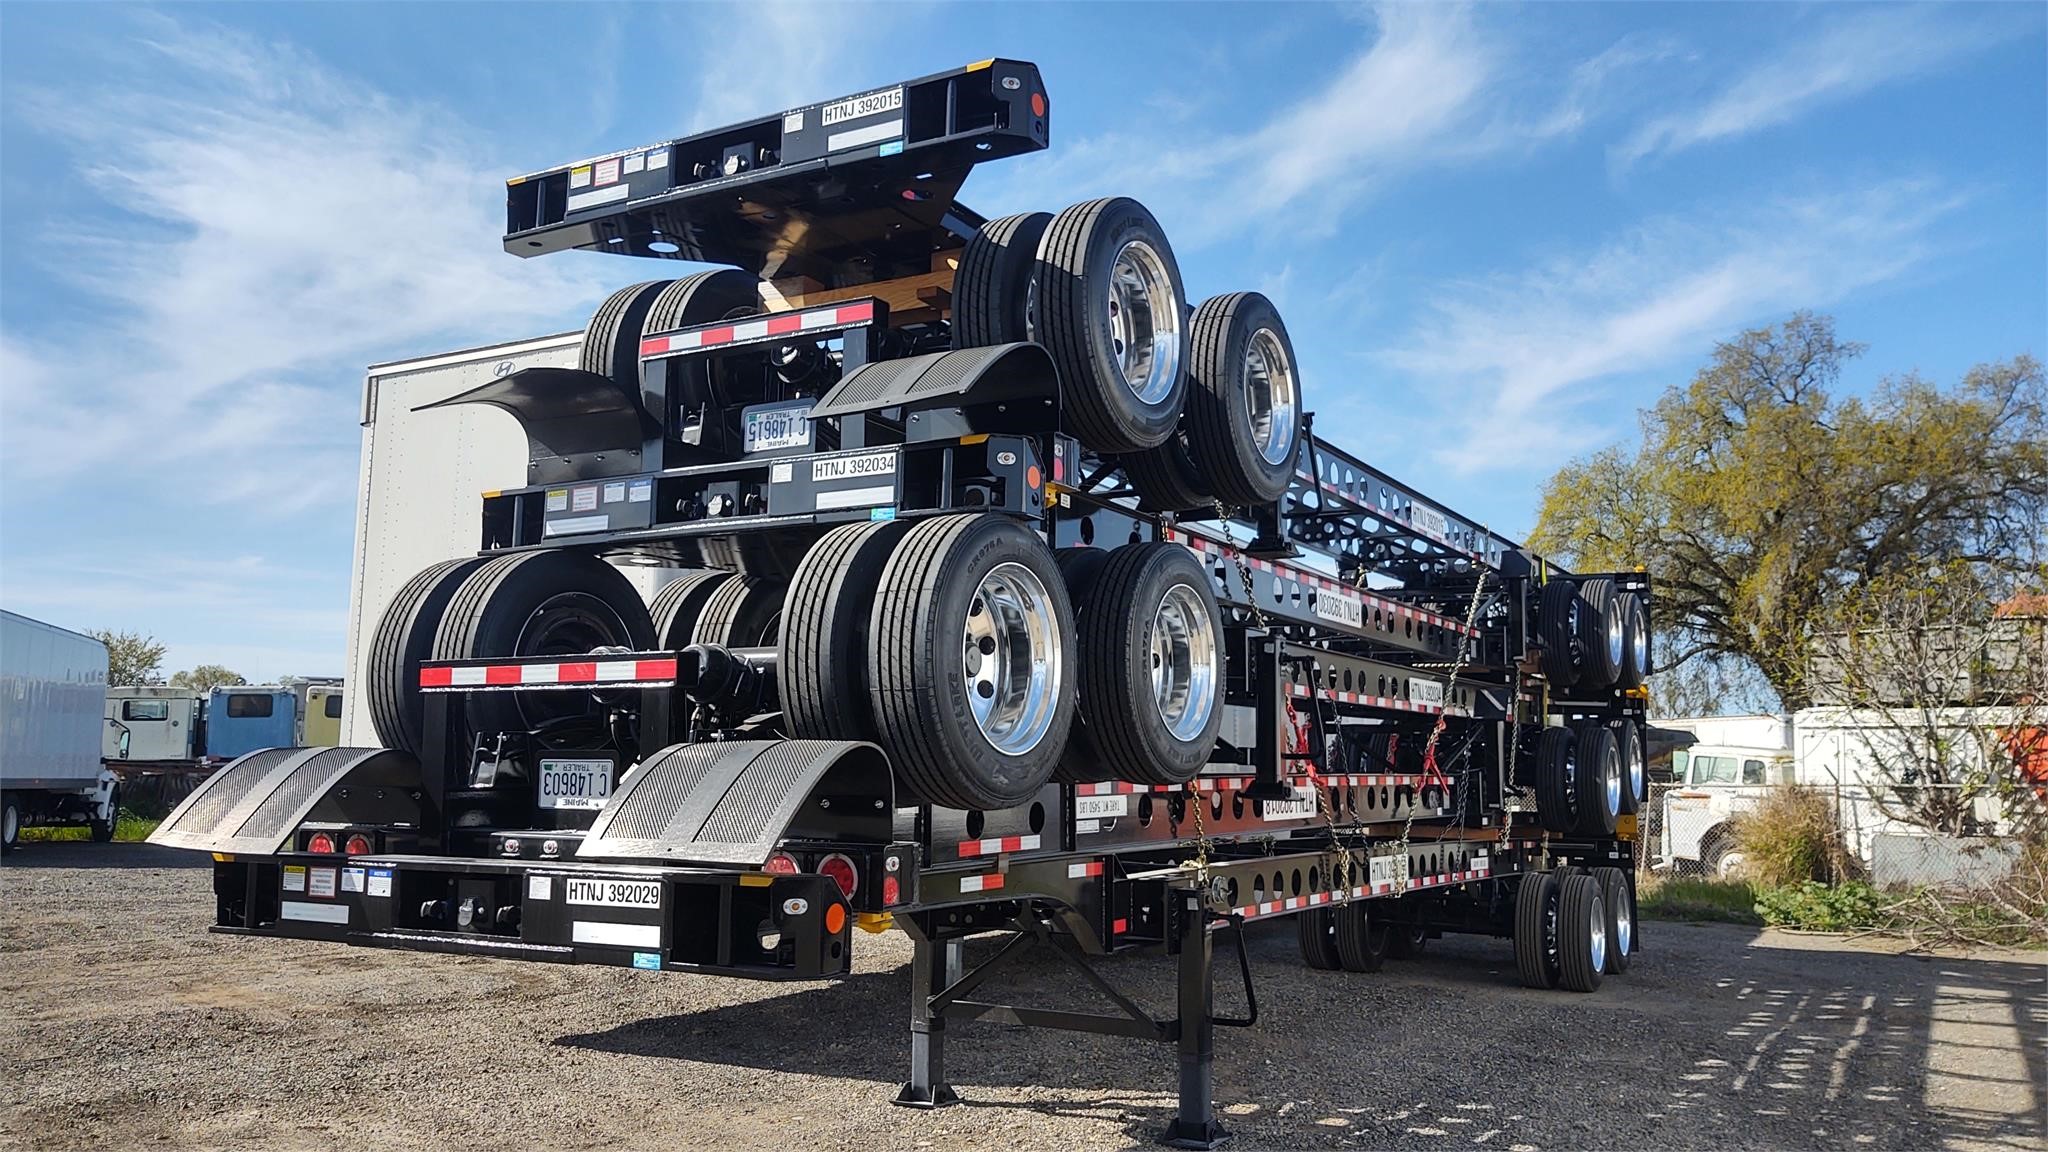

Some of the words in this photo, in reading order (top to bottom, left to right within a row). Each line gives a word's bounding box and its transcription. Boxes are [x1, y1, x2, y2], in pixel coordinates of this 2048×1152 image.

[825, 102, 855, 122] HTNJ
[858, 91, 901, 114] 392015
[765, 411, 790, 420] TRAILER
[798, 416, 806, 436] C
[748, 417, 794, 442] 148615
[766, 439, 789, 447] MAINE
[815, 461, 846, 478] HTNJ
[849, 456, 894, 473] 392034
[1412, 506, 1426, 527] HTNJ
[1319, 593, 1343, 618] 392030
[1343, 601, 1360, 624] HTNJ
[1410, 682, 1424, 700] HTNJ
[562, 763, 591, 772] TRAILER
[543, 772, 593, 796] 148603
[598, 773, 607, 796] C
[562, 798, 589, 806] MAINE
[569, 882, 604, 901] HTNJ
[608, 884, 659, 904] 392029
